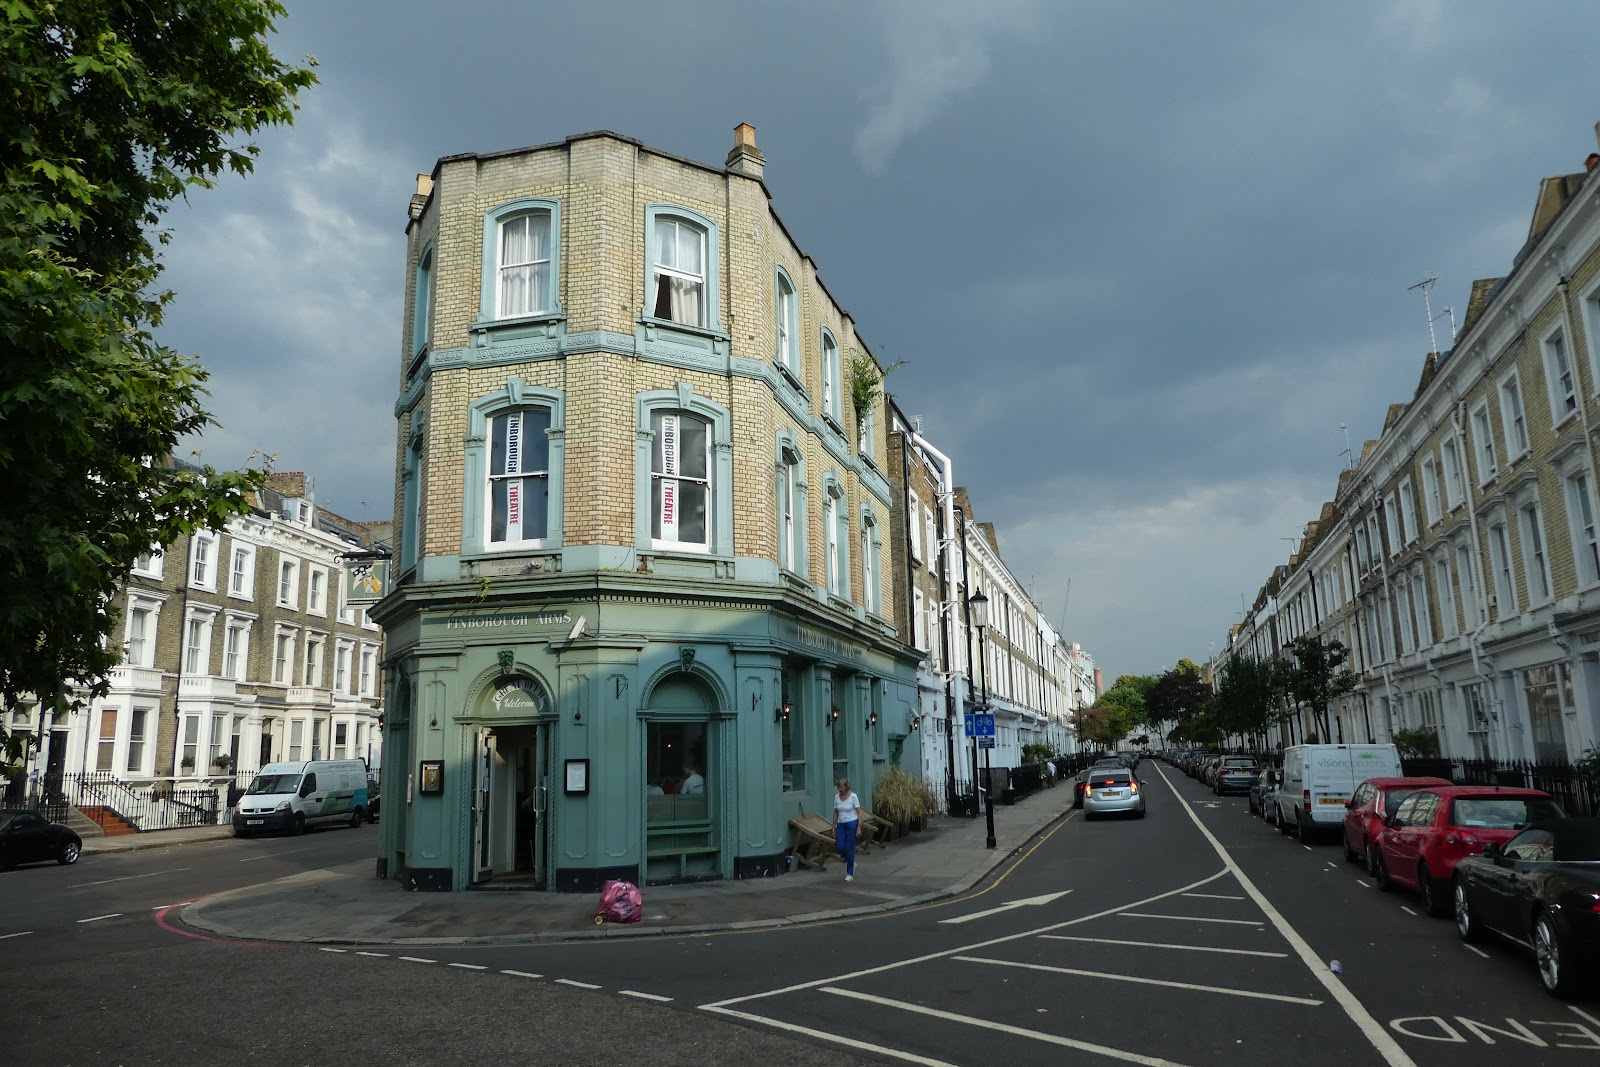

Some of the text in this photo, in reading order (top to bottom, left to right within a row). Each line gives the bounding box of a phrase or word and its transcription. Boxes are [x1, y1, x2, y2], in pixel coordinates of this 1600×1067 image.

[507, 415, 520, 525] FINBOROUGH THEATRE
[664, 417, 676, 525] FINBOROUGH THEATRE
[491, 558, 533, 567] FINBOROUG
[446, 612, 573, 629] FINBOROUGH ARMS
[494, 680, 546, 702] GREAT BEER
[503, 697, 536, 708] Welcome
[1389, 1016, 1600, 1049] END
